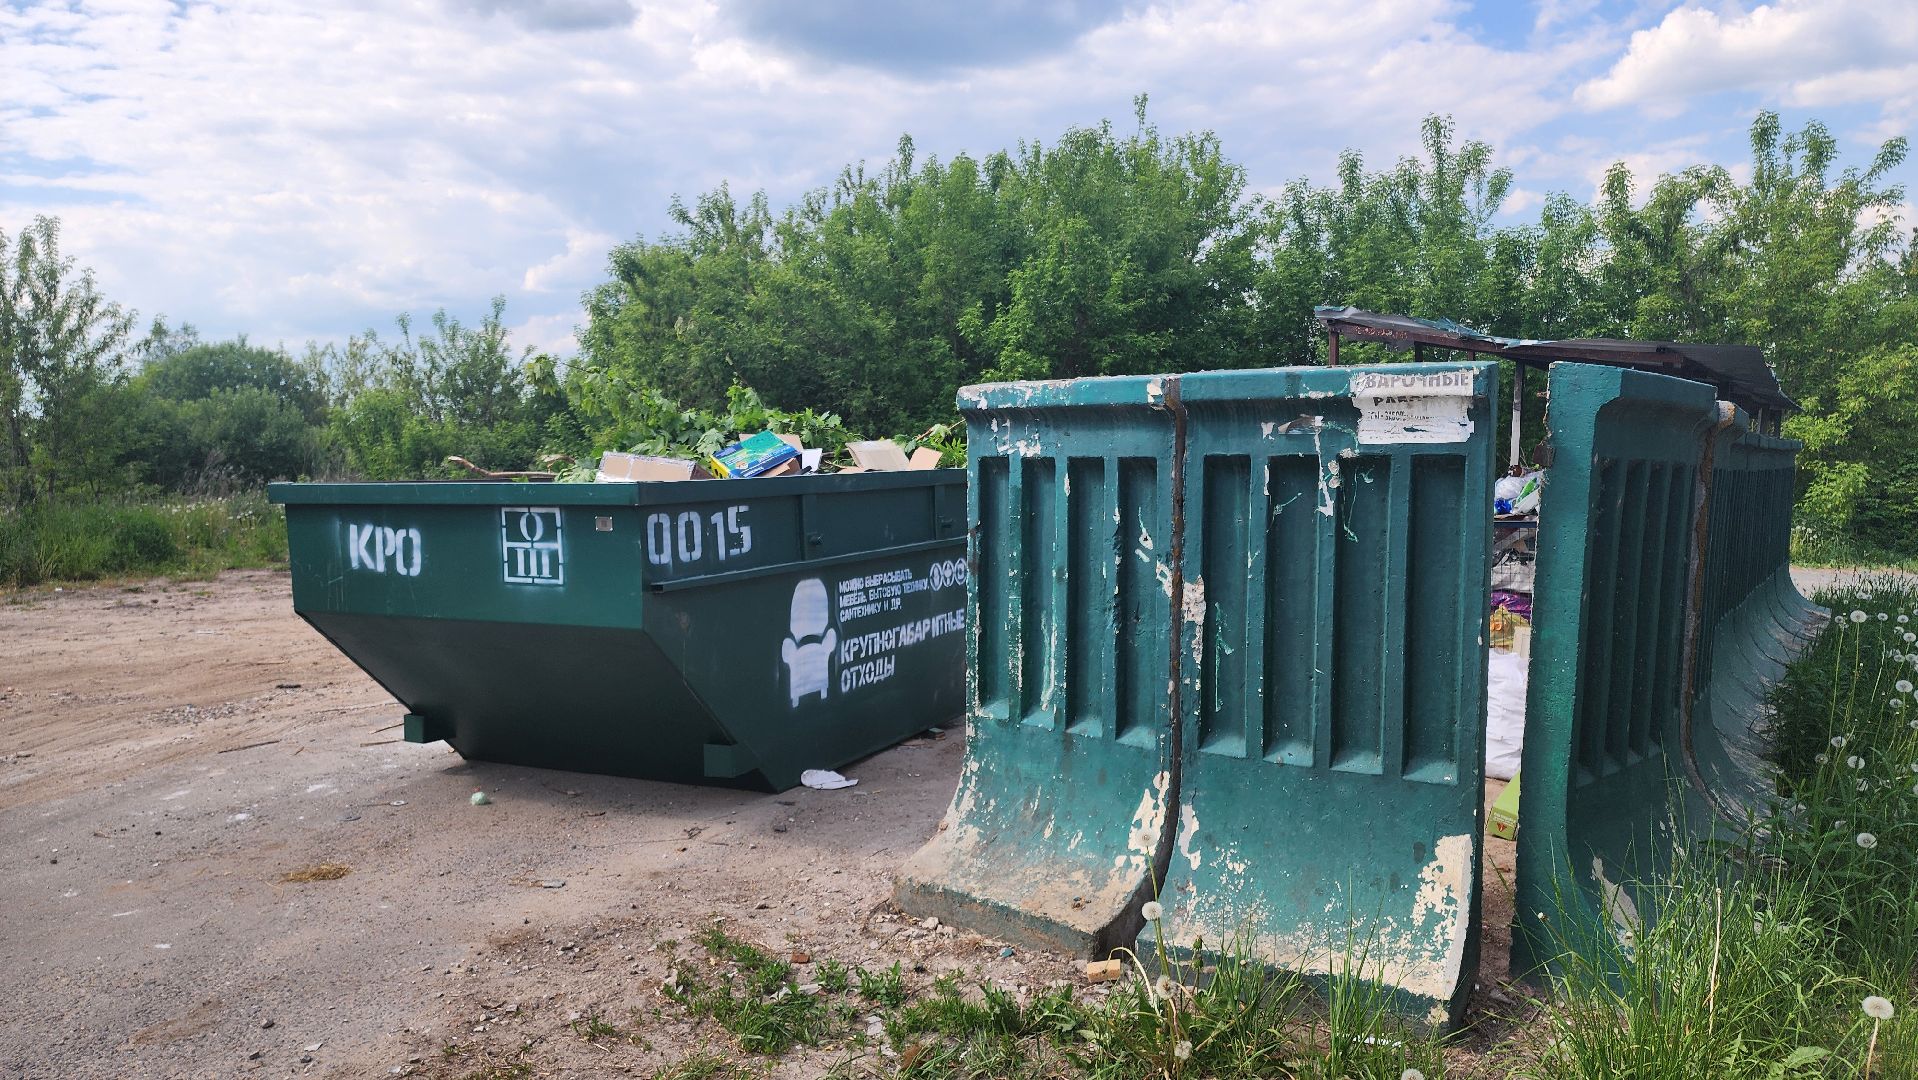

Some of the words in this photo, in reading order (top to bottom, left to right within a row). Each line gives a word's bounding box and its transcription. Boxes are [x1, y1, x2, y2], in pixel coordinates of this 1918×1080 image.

[1359, 373, 1469, 389] ВАРОЧНЫЕ
[349, 523, 423, 577] КРО
[646, 505, 752, 565] 0015
[838, 578, 864, 593] МОЖНО
[865, 568, 912, 587] ВЫБРАСЫВАТЬ
[868, 584, 902, 602] БЫТОВУЮ
[839, 602, 882, 622] САНТЕХНИКУ
[883, 600, 890, 611] И
[840, 608, 965, 664] КРУПНОГАБАРИТНЫЕ
[840, 654, 895, 693] ОТХОДЫ
